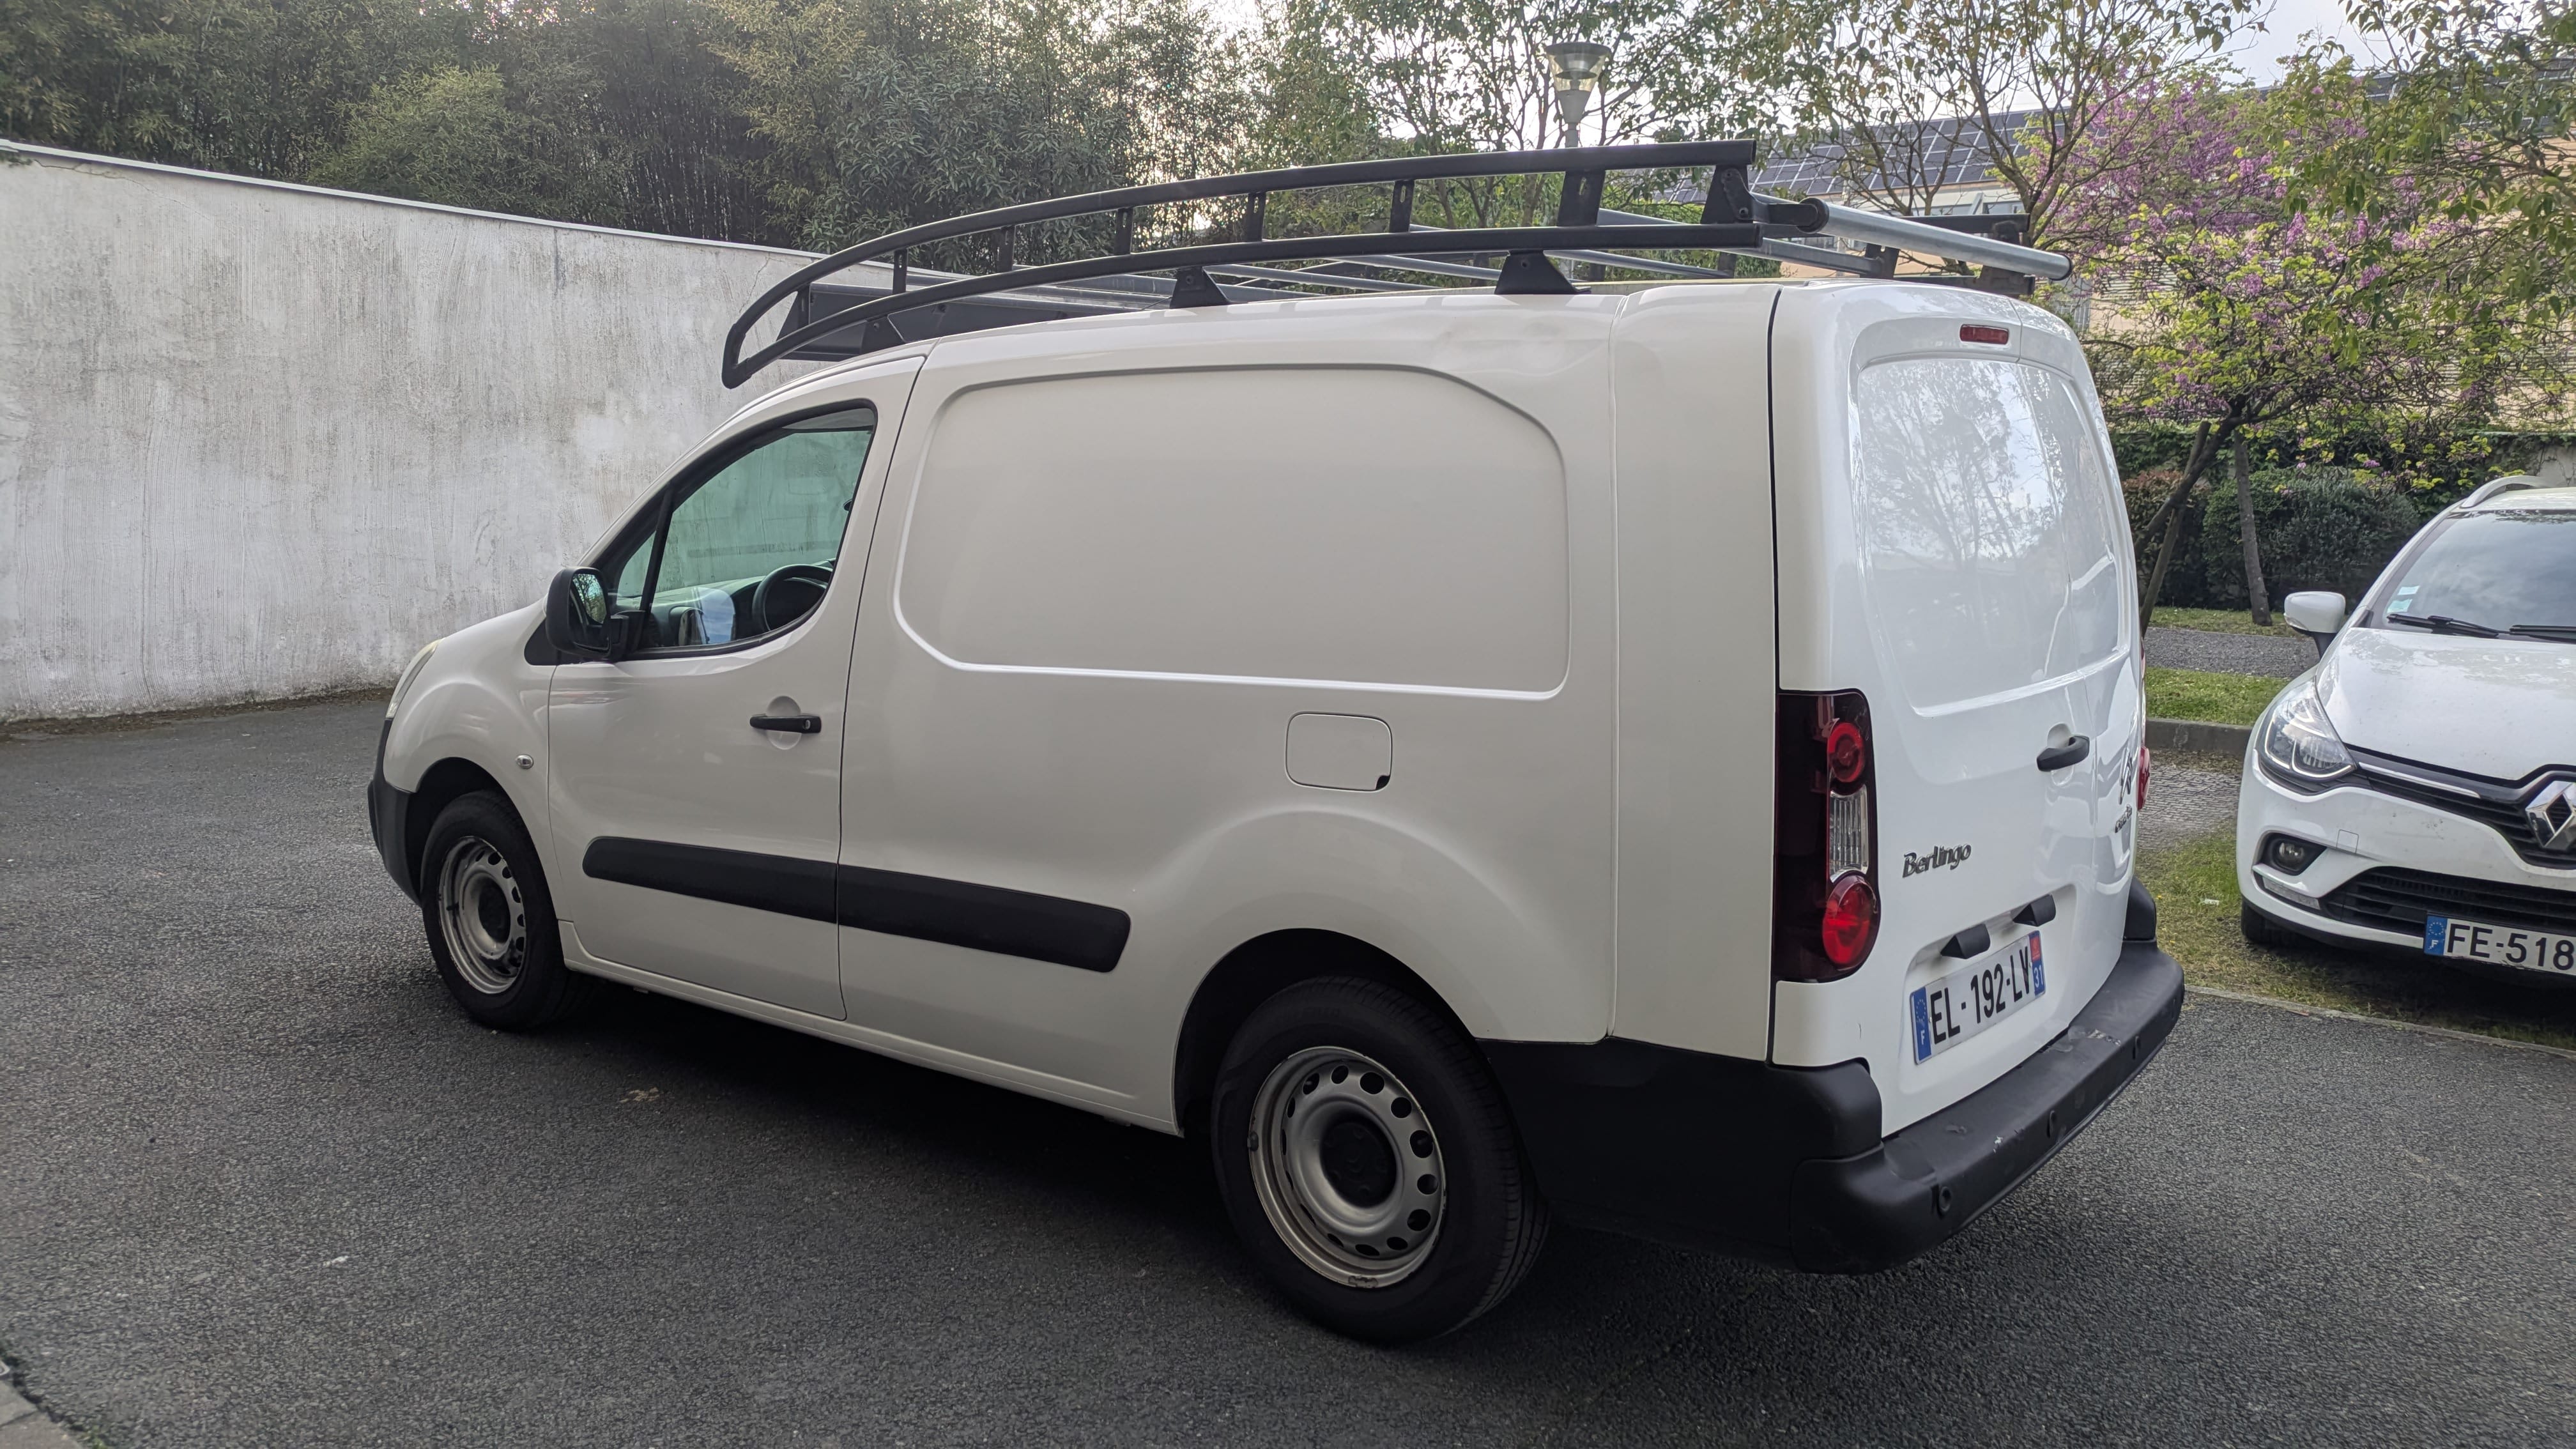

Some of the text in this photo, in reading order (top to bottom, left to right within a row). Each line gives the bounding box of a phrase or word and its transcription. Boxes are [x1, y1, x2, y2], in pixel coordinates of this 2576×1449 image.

[1902, 843, 1972, 878] Berlingo
[2430, 939, 2439, 948] F
[2448, 923, 2575, 970] FE-518
[2034, 965, 2044, 988] 31
[1929, 946, 2030, 1045] EL-192-LV
[1920, 1030, 1926, 1046] F
